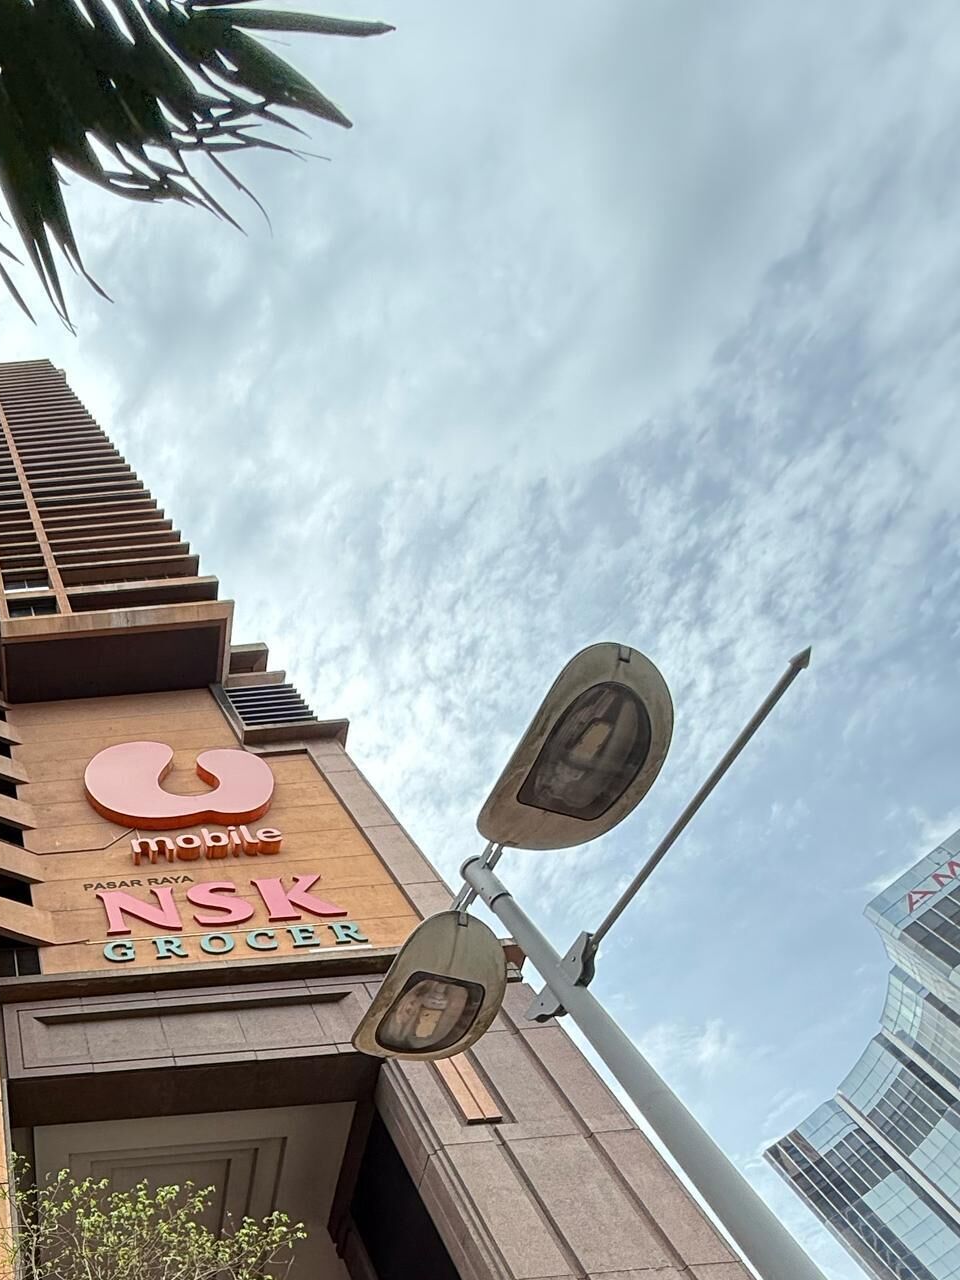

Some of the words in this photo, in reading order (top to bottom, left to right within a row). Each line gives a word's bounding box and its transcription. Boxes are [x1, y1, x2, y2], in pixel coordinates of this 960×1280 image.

[131, 825, 283, 865] mobile
[83, 878, 143, 891] PASAR
[147, 875, 194, 887] RAYA
[96, 874, 348, 936] NSK
[103, 921, 369, 962] GROCER
